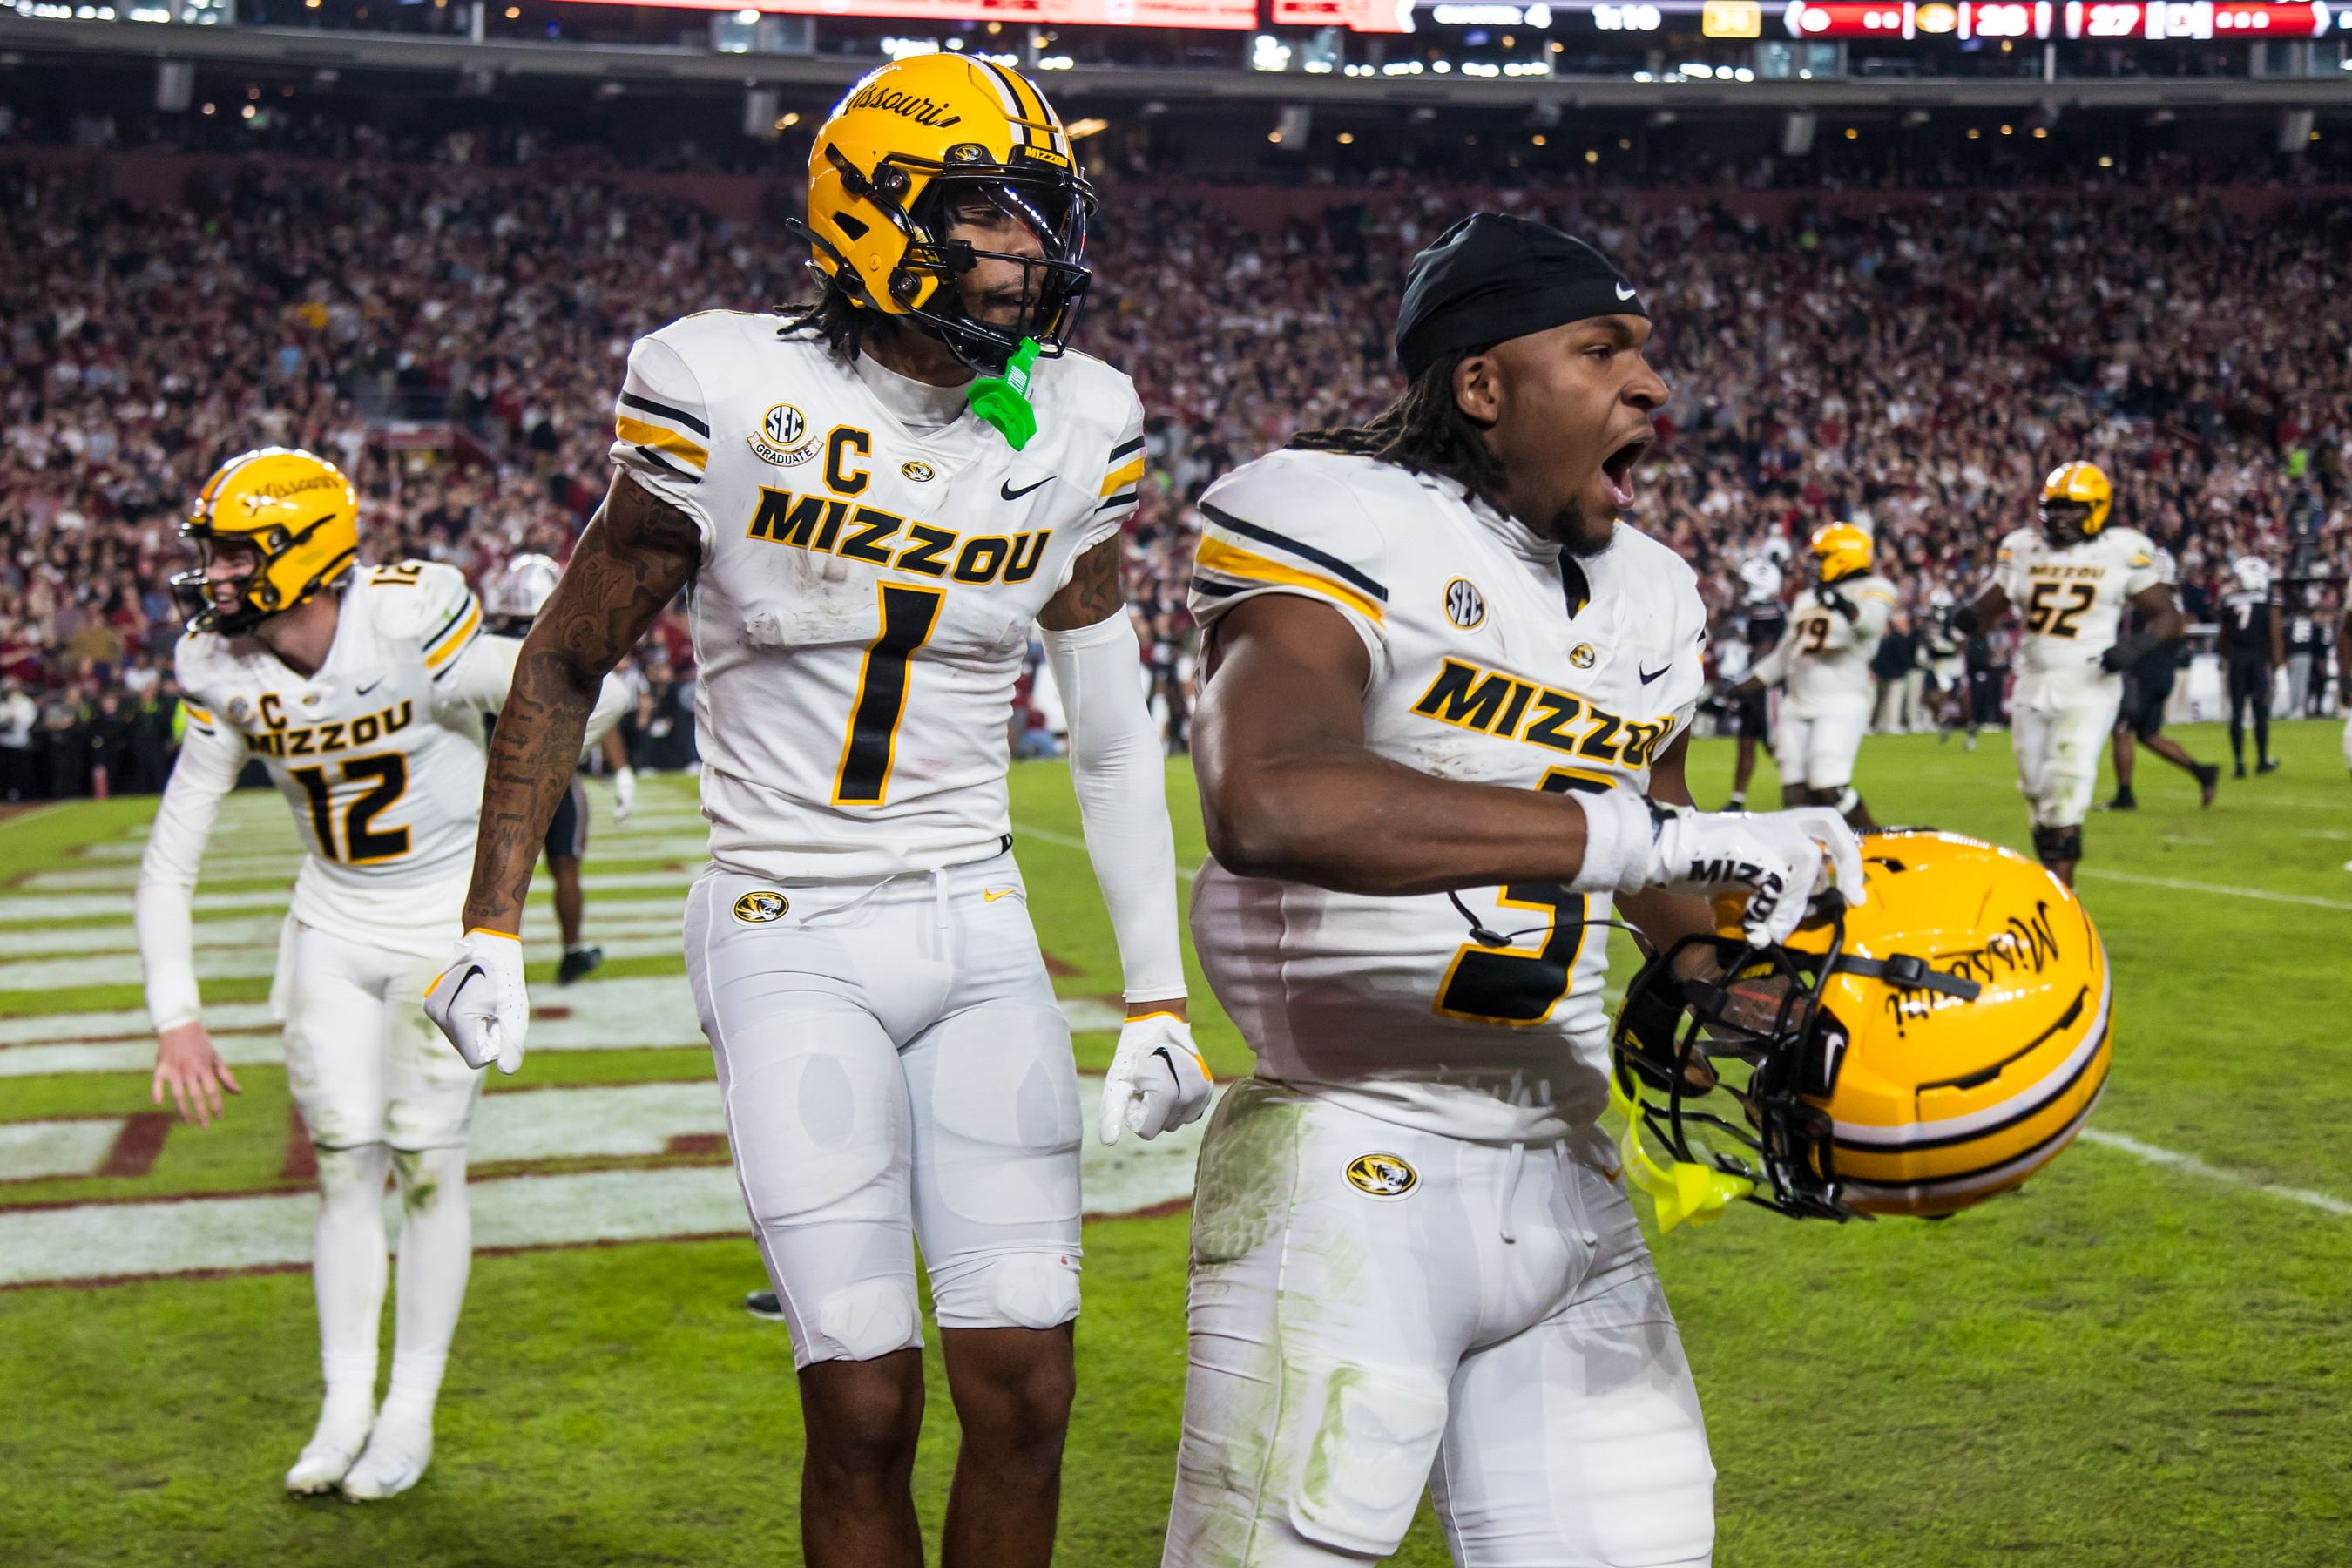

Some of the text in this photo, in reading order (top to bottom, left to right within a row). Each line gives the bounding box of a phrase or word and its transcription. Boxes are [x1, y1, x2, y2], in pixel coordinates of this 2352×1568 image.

[1024, 146, 1068, 167] MIZZOU
[766, 405, 803, 442] SEC
[755, 443, 814, 464] GRADUATE
[822, 423, 872, 498] C
[746, 485, 1052, 585] MIZZOU
[1446, 580, 1483, 626] SEC
[2026, 581, 2098, 640] 52
[259, 693, 287, 732] C
[830, 579, 947, 806] 1
[287, 750, 413, 866] 12
